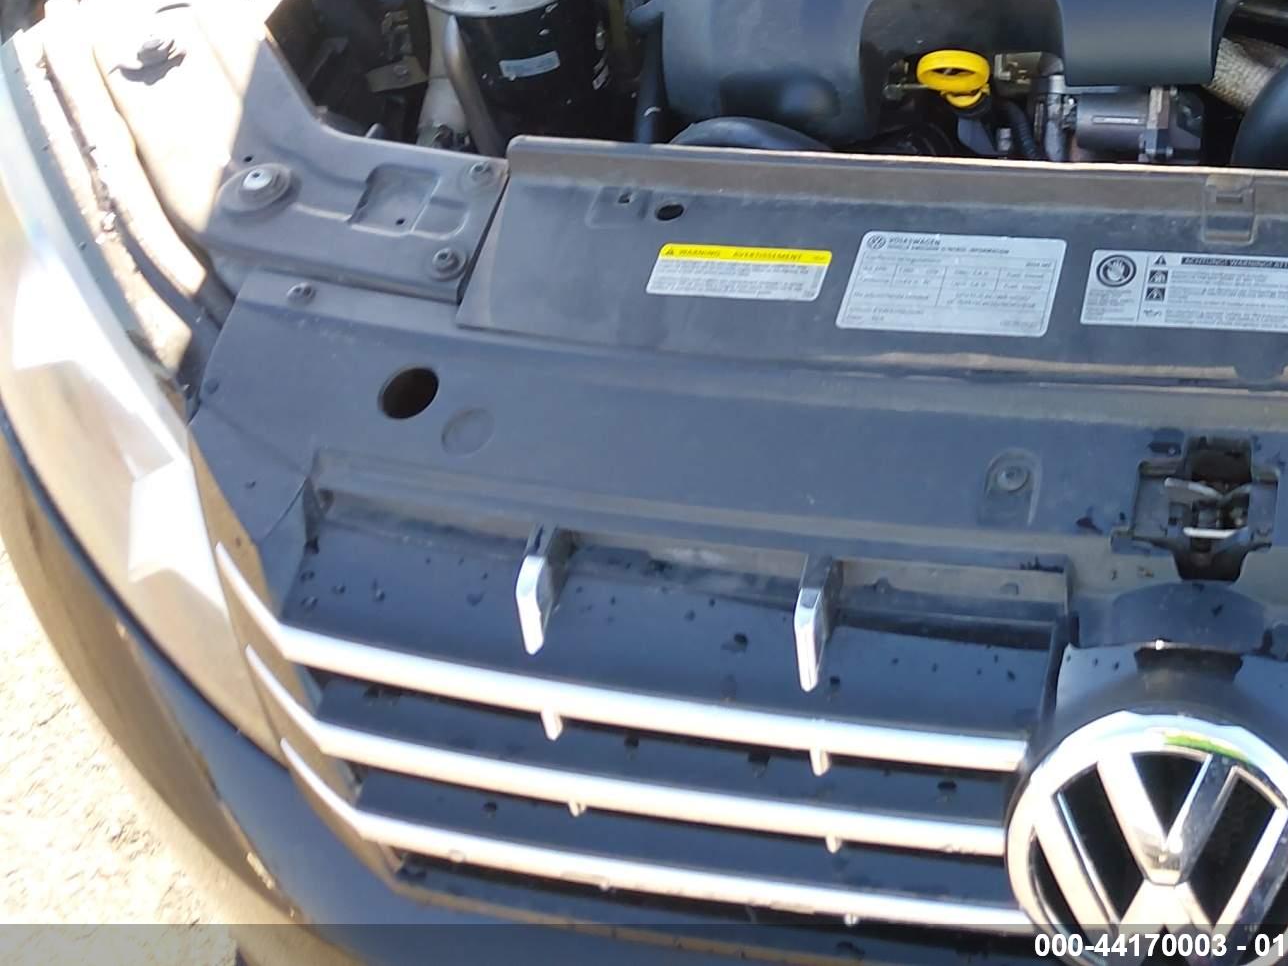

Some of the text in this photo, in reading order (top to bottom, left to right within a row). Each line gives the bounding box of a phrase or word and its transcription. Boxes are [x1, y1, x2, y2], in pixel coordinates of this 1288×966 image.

[888, 236, 941, 246] VOLKSWAGEN
[678, 249, 802, 261] WARNING AVERTISSEMENT
